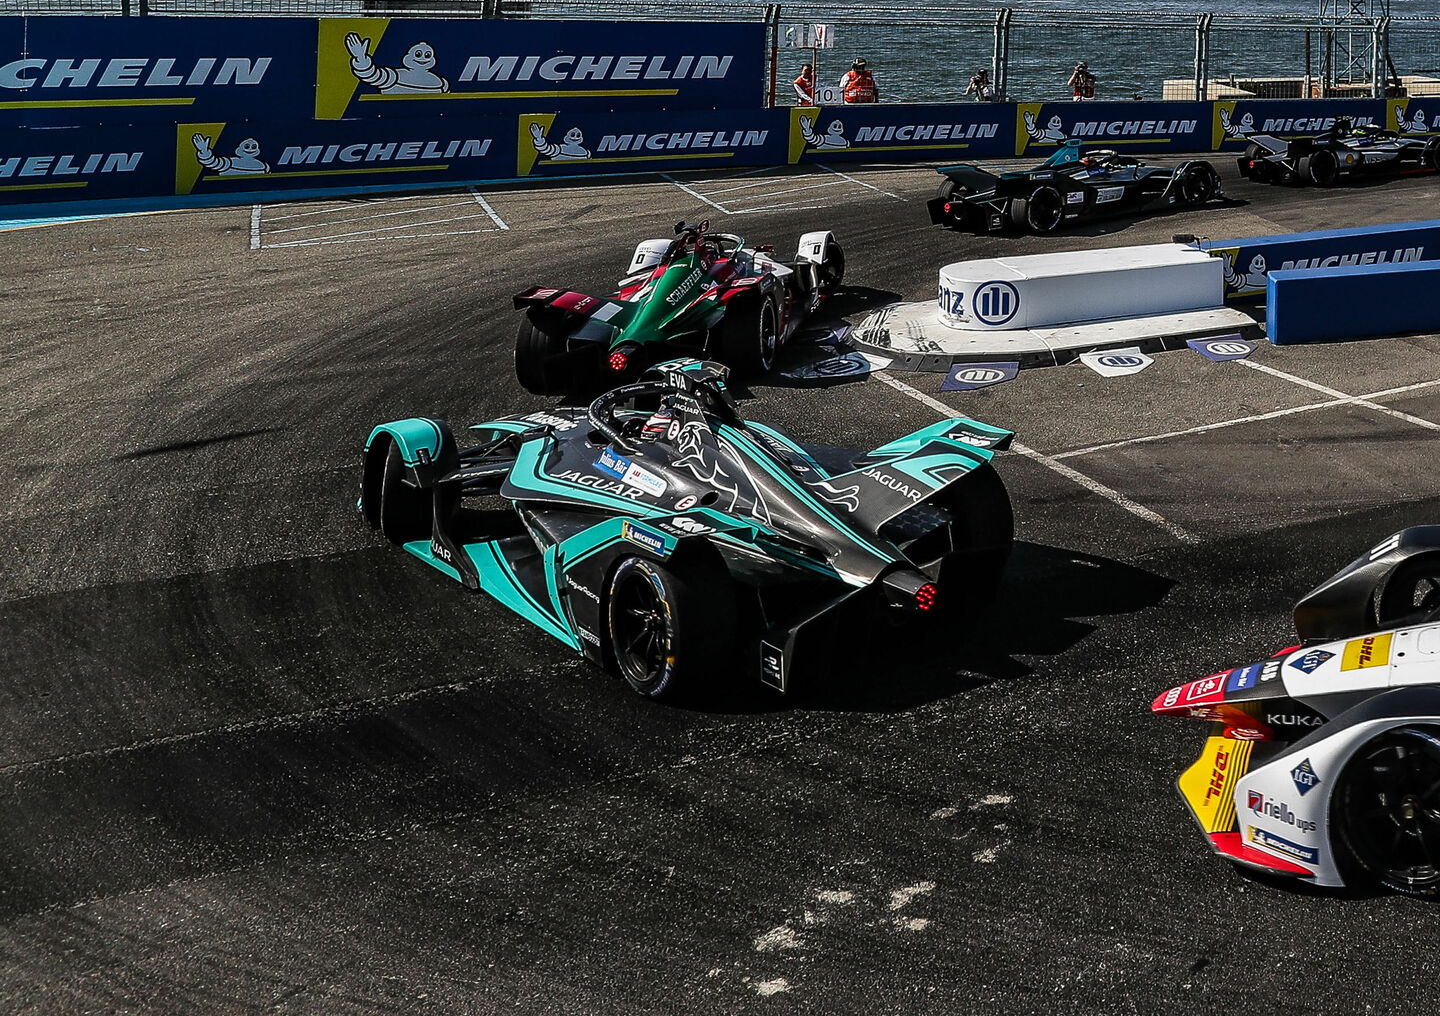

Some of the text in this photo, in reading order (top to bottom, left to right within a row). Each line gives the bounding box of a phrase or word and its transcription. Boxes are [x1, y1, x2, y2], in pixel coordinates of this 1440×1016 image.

[458, 55, 734, 82] MICHELIN
[855, 122, 999, 142] MICHELIN
[1072, 119, 1197, 136] MICHELIN
[277, 138, 492, 165] MICHELIN
[597, 130, 768, 152] MICHELIN
[666, 267, 703, 306] SCHAEFFLER
[670, 372, 687, 390] EVA
[672, 403, 700, 415] JAGUAR
[550, 469, 645, 500] JAGUAR
[861, 468, 922, 502] JAGUAR
[633, 532, 663, 549] MICHELIN
[1359, 637, 1375, 664] DHL
[1261, 661, 1280, 681] ABB
[1267, 715, 1323, 726] KUKA
[1206, 752, 1229, 800] DHL
[1294, 769, 1315, 786] LGT
[1264, 798, 1316, 833] riello ups
